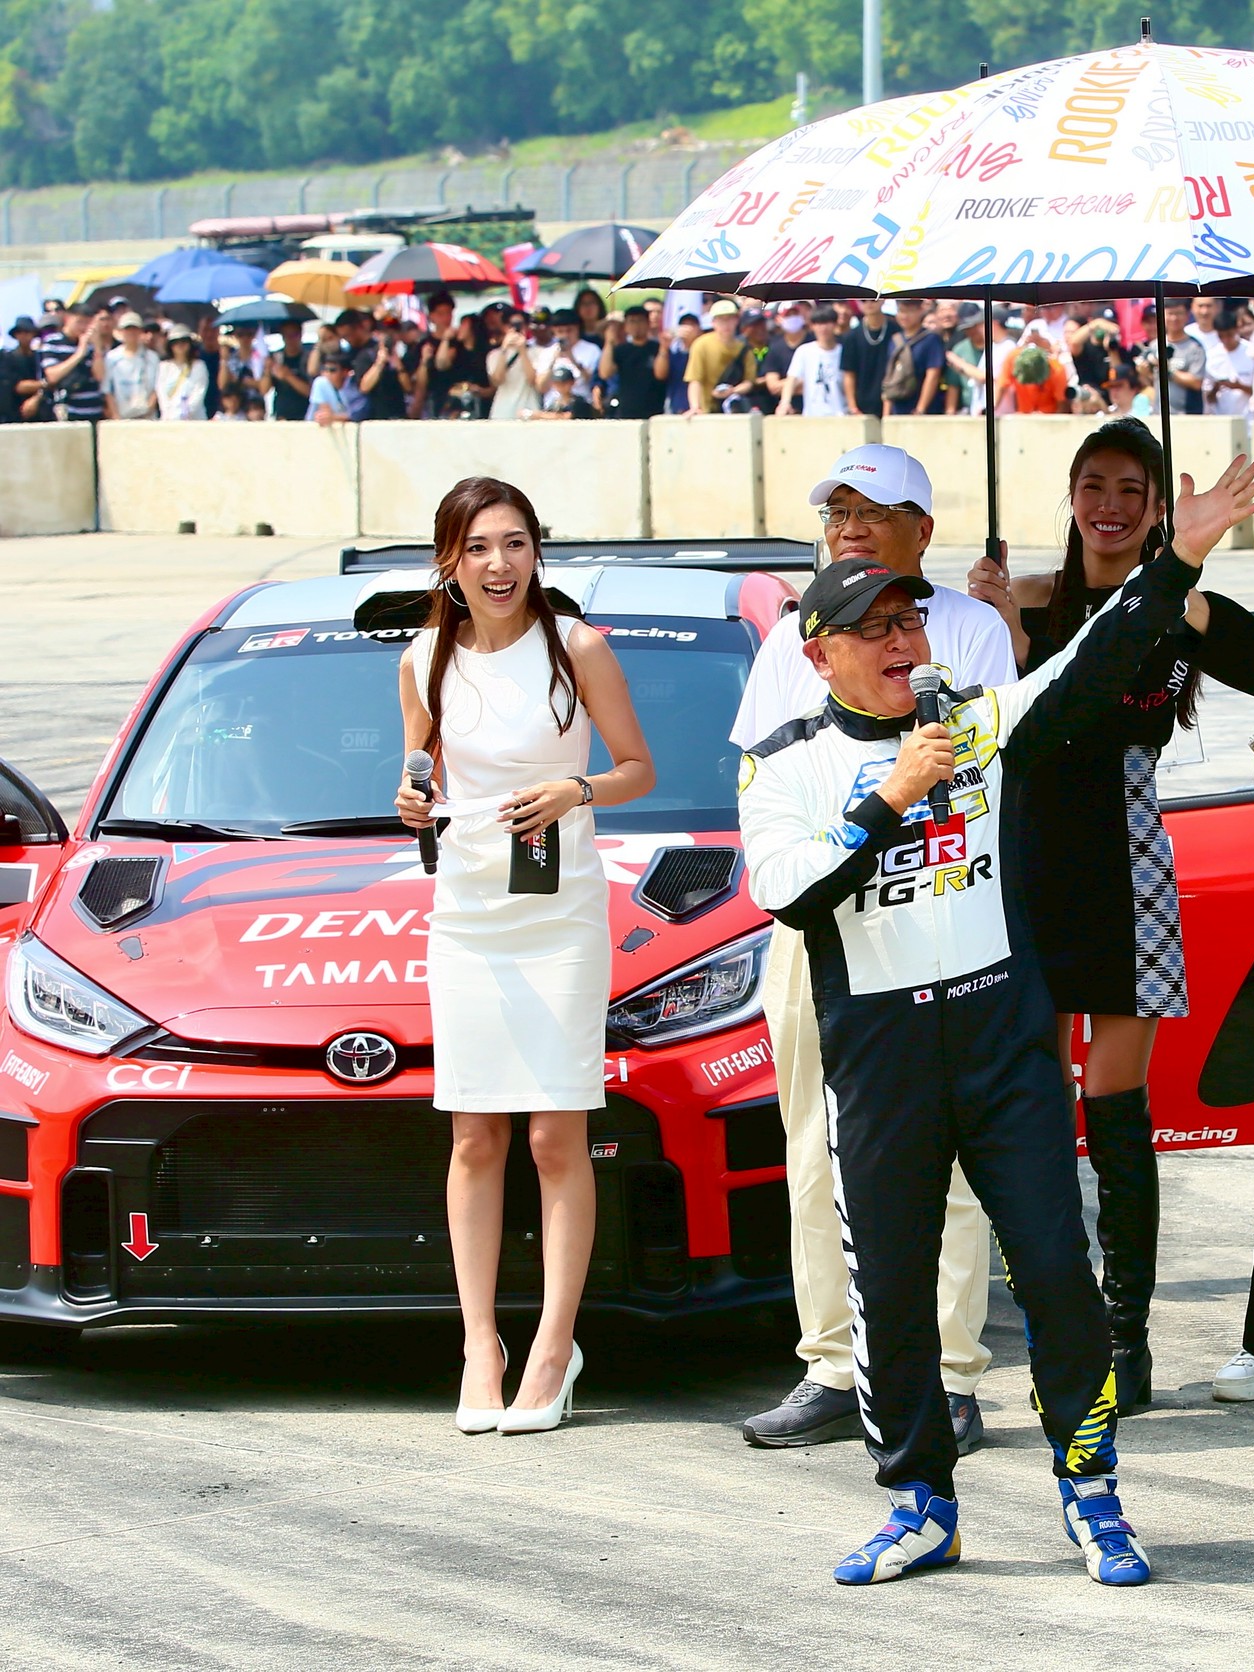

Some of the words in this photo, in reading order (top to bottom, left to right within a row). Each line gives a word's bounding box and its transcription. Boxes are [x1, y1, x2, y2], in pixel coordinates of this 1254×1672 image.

[1048, 61, 1150, 165] ROOKIE
[955, 196, 1045, 220] ROOKIE
[1045, 192, 1137, 216] RACING
[842, 570, 867, 589] ROOKIE
[246, 632, 303, 652] GR
[341, 731, 380, 749] OMP
[883, 833, 967, 876] GR
[849, 853, 994, 913] TG-RR
[946, 973, 993, 1000] MORIZO
[1151, 1126, 1238, 1143] Racing
[591, 1145, 617, 1157] GR
[1099, 1520, 1120, 1530] ROOKIE
